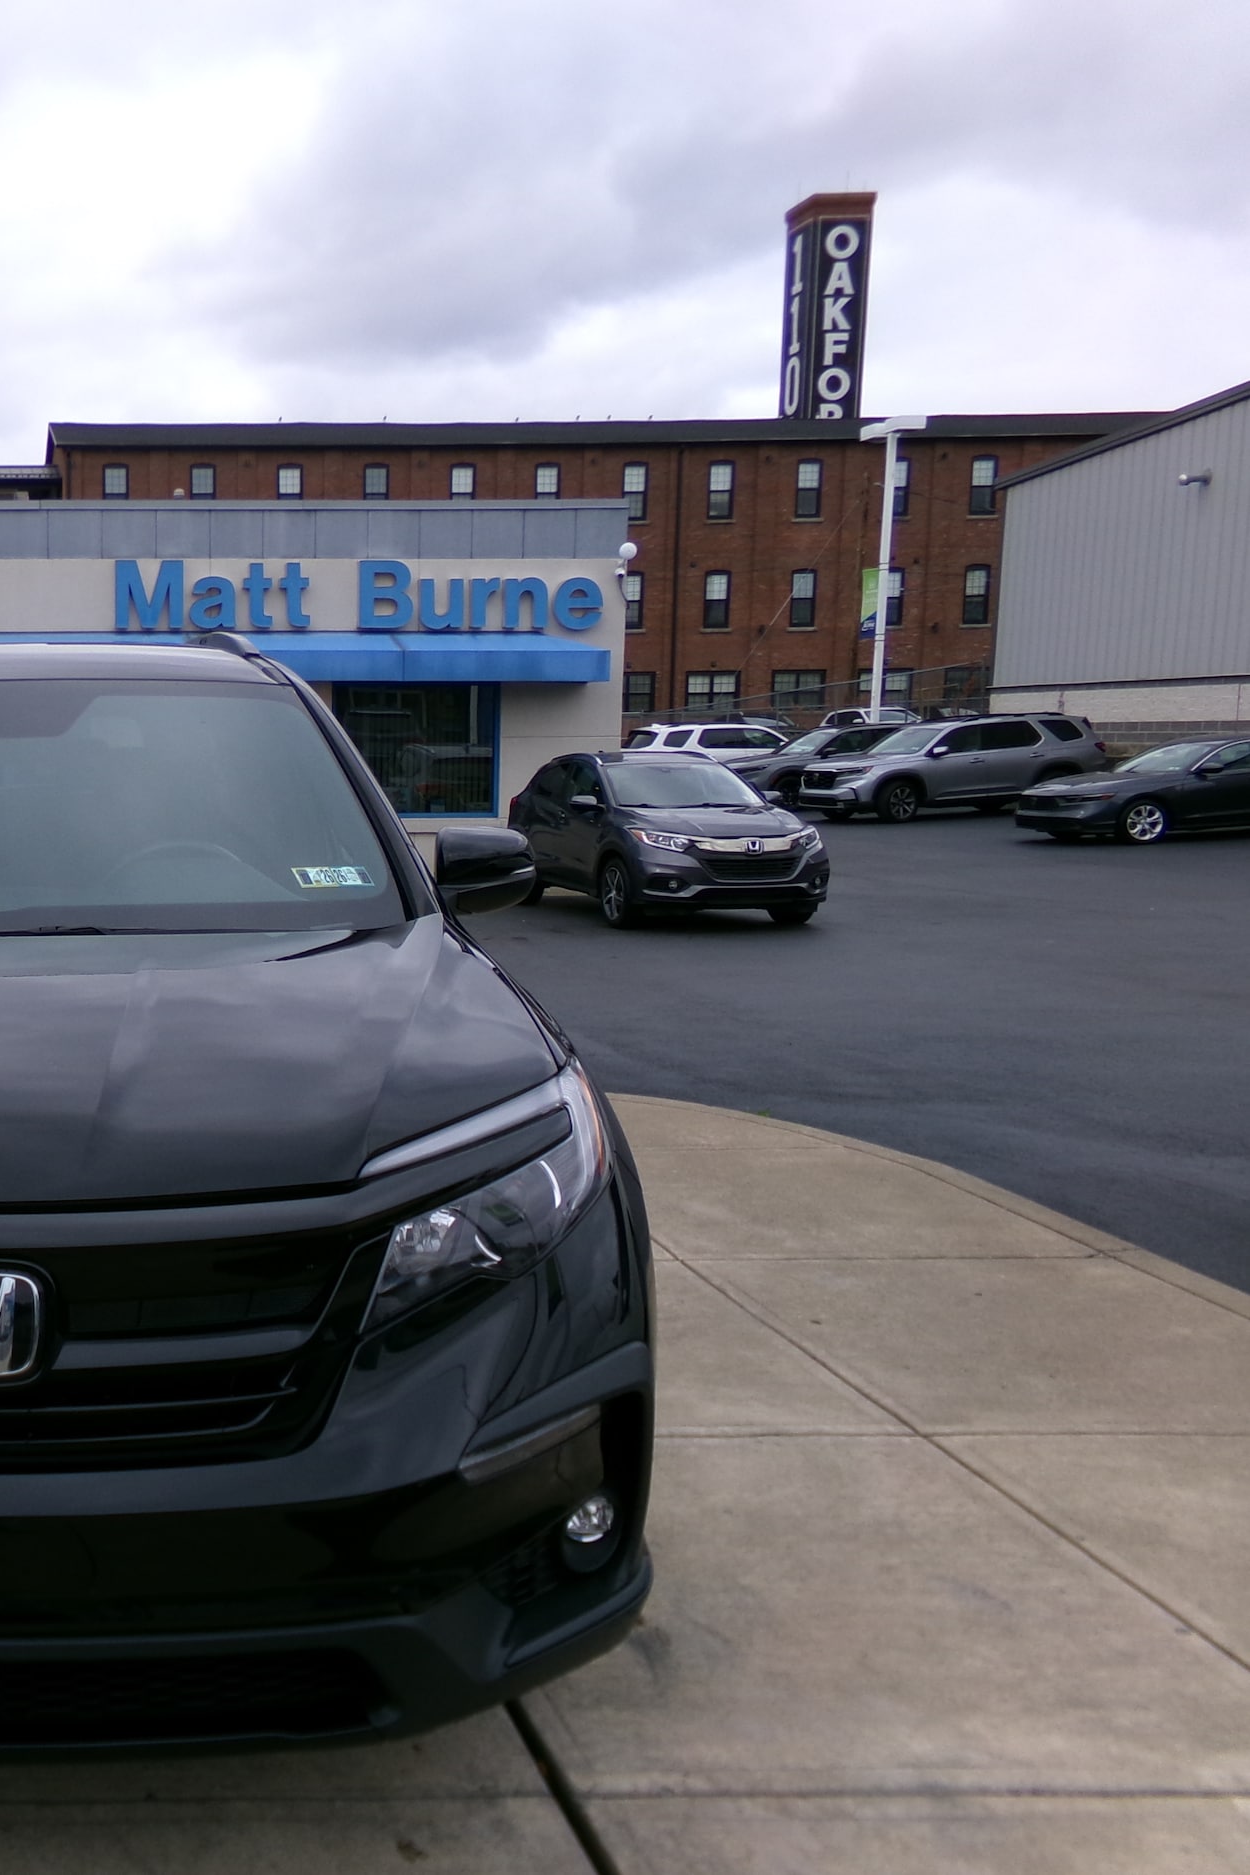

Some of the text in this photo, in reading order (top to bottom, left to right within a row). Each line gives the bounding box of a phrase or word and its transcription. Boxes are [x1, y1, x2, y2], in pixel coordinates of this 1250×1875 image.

[784, 234, 803, 416] 110
[114, 559, 604, 631] Matt Burne
